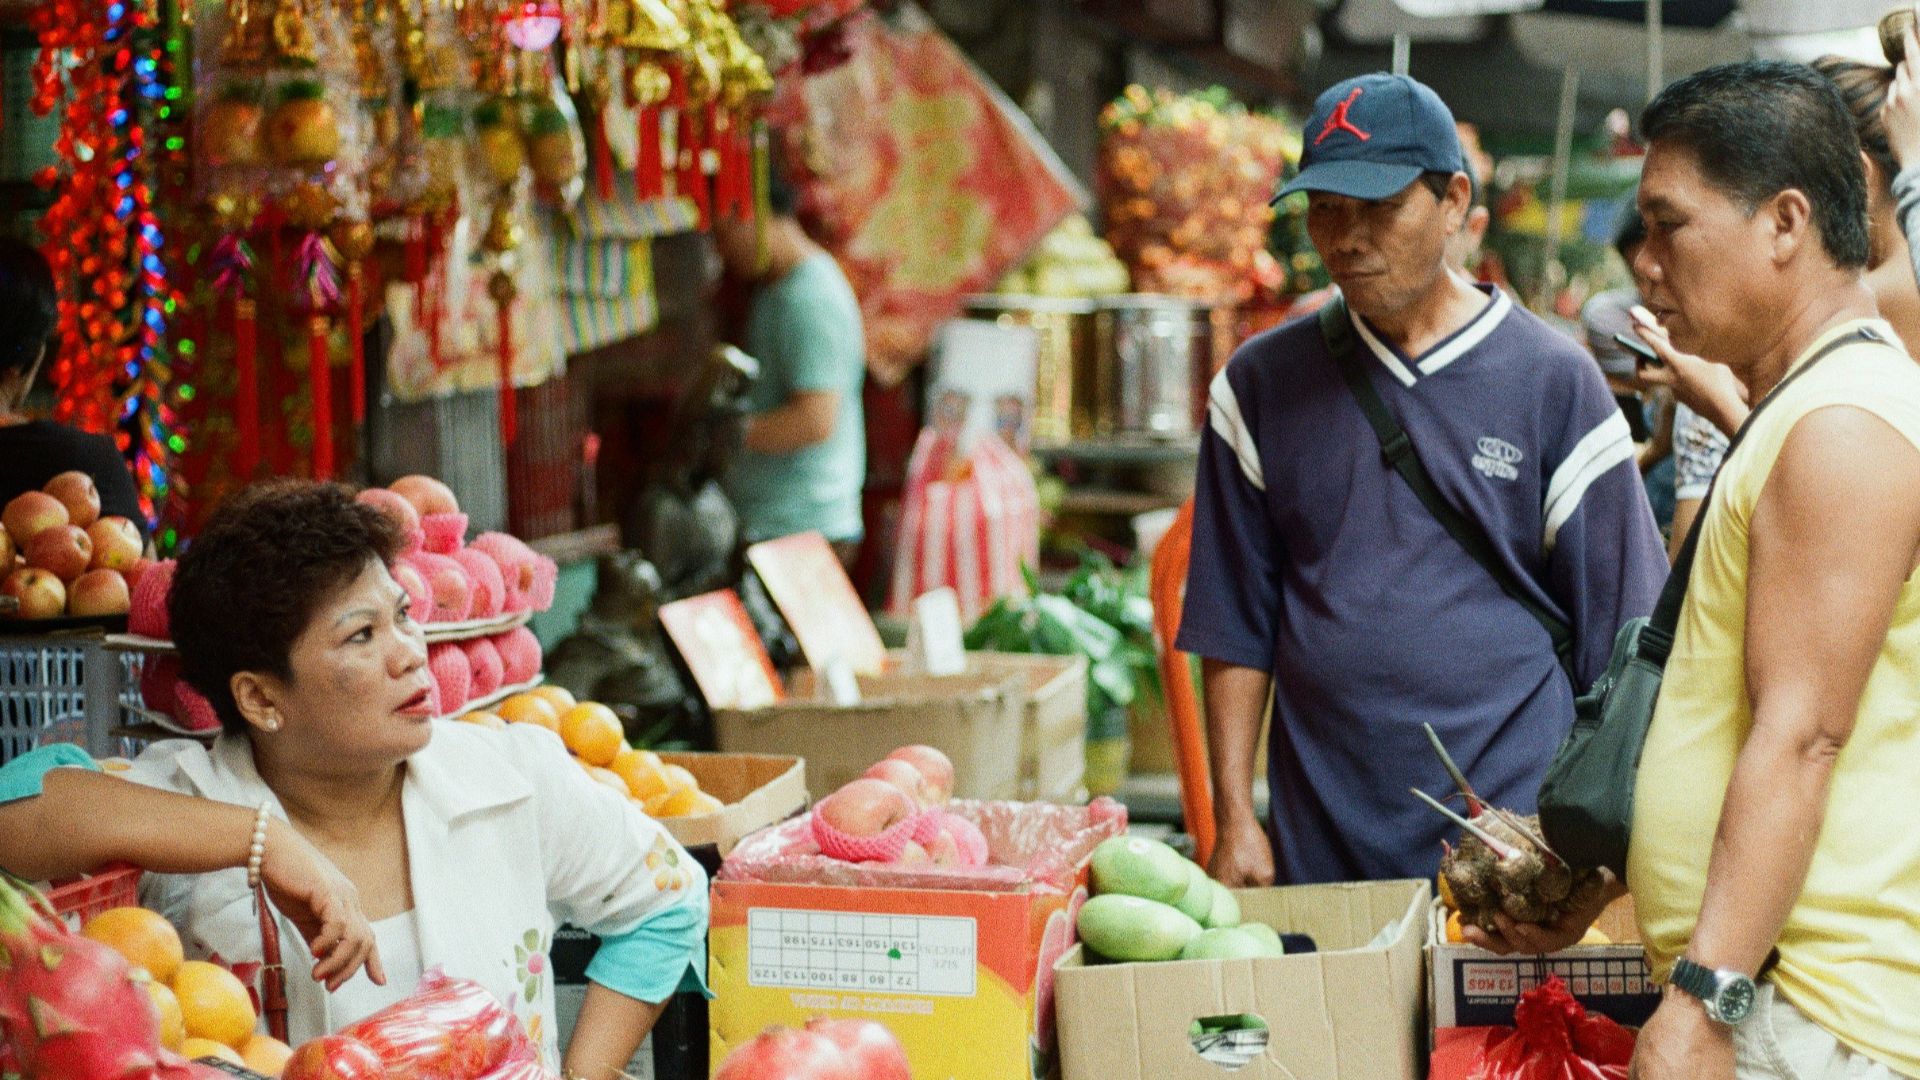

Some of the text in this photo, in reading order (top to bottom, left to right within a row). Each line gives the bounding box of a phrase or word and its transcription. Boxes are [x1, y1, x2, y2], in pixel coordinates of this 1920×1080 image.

[811, 936, 833, 946] 175
[838, 938, 860, 948] 163
[865, 940, 887, 949] 150
[754, 969, 777, 979] 125
[784, 970, 806, 980] 113
[811, 972, 833, 981] 100
[869, 975, 885, 985] 80
[896, 976, 912, 986] 72
[1467, 979, 1495, 991] KGS
[1499, 979, 1514, 991] 13
